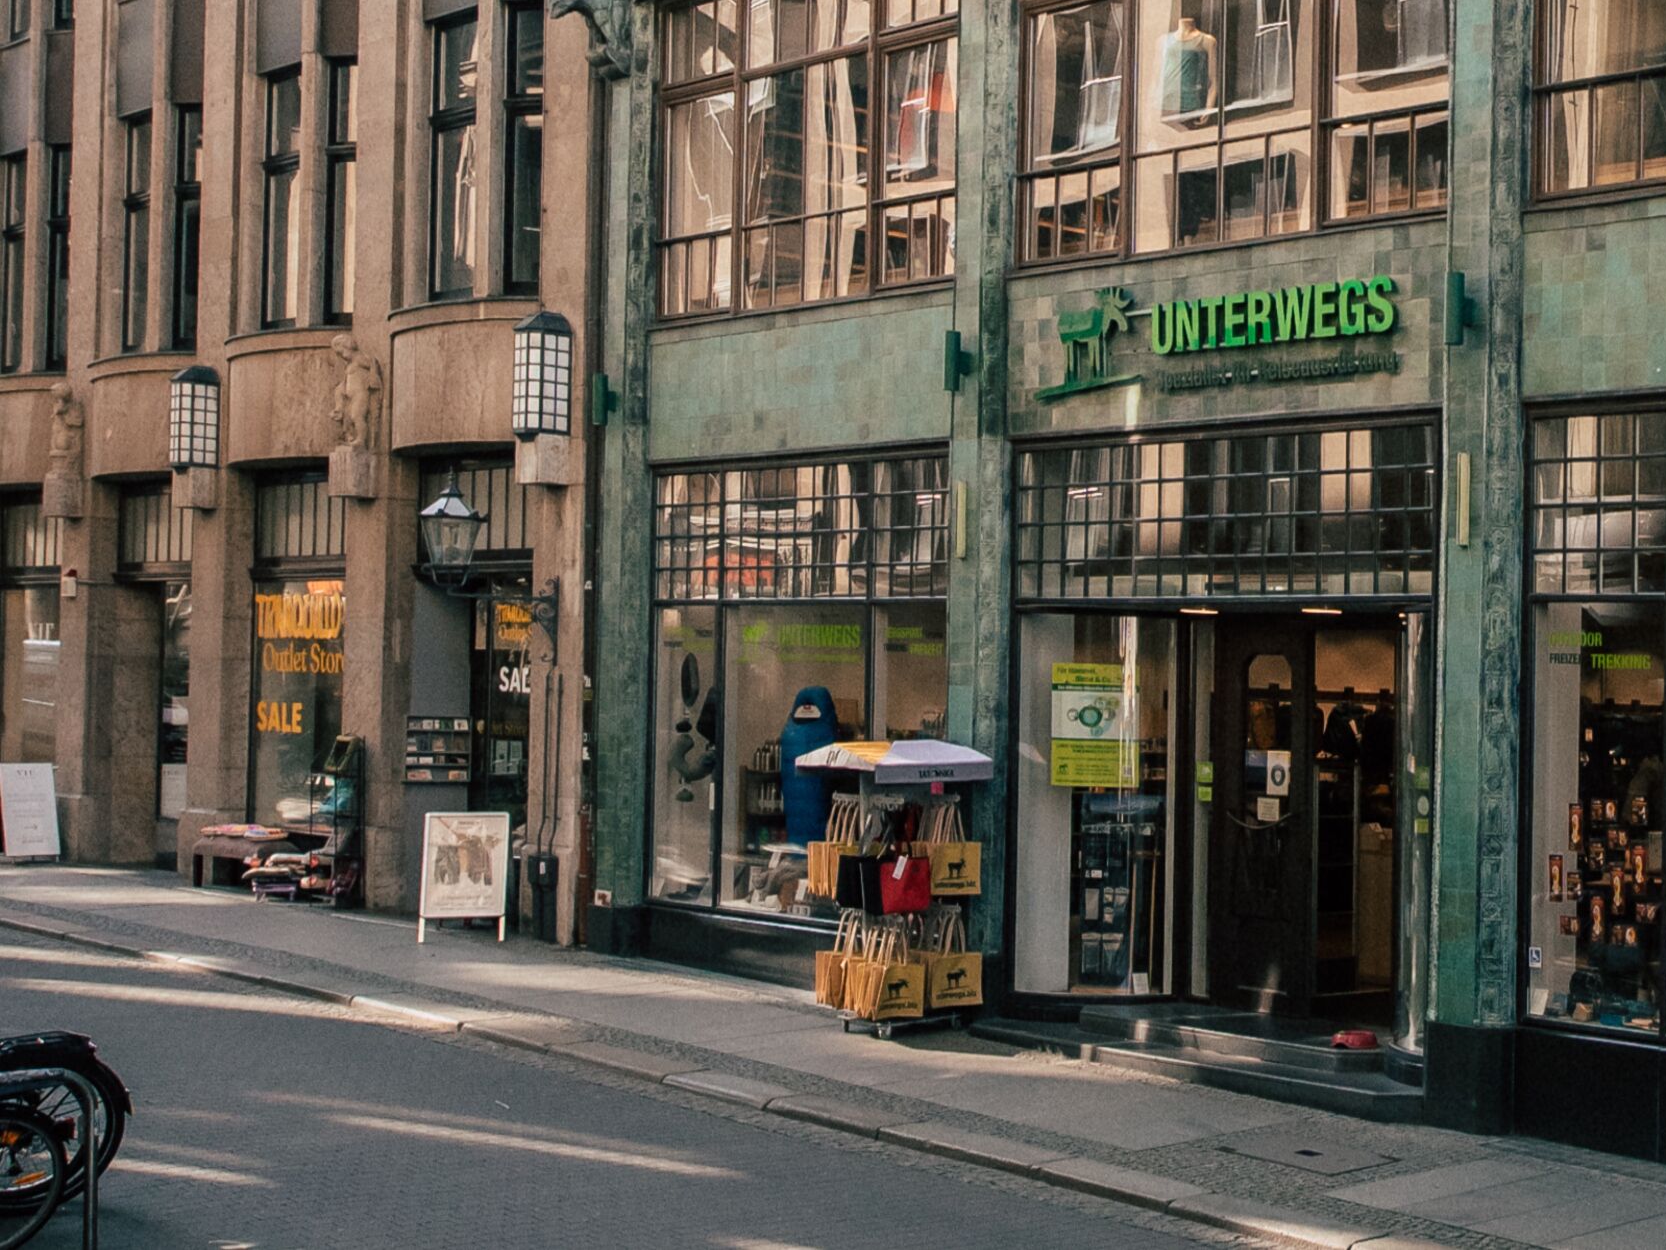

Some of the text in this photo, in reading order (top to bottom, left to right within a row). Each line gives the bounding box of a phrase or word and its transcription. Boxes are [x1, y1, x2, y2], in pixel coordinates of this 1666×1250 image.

[1151, 275, 1395, 356] UNTERWEGS
[263, 642, 307, 673] Outlet
[1591, 654, 1651, 669] TREKKING
[256, 701, 303, 734] SALE
